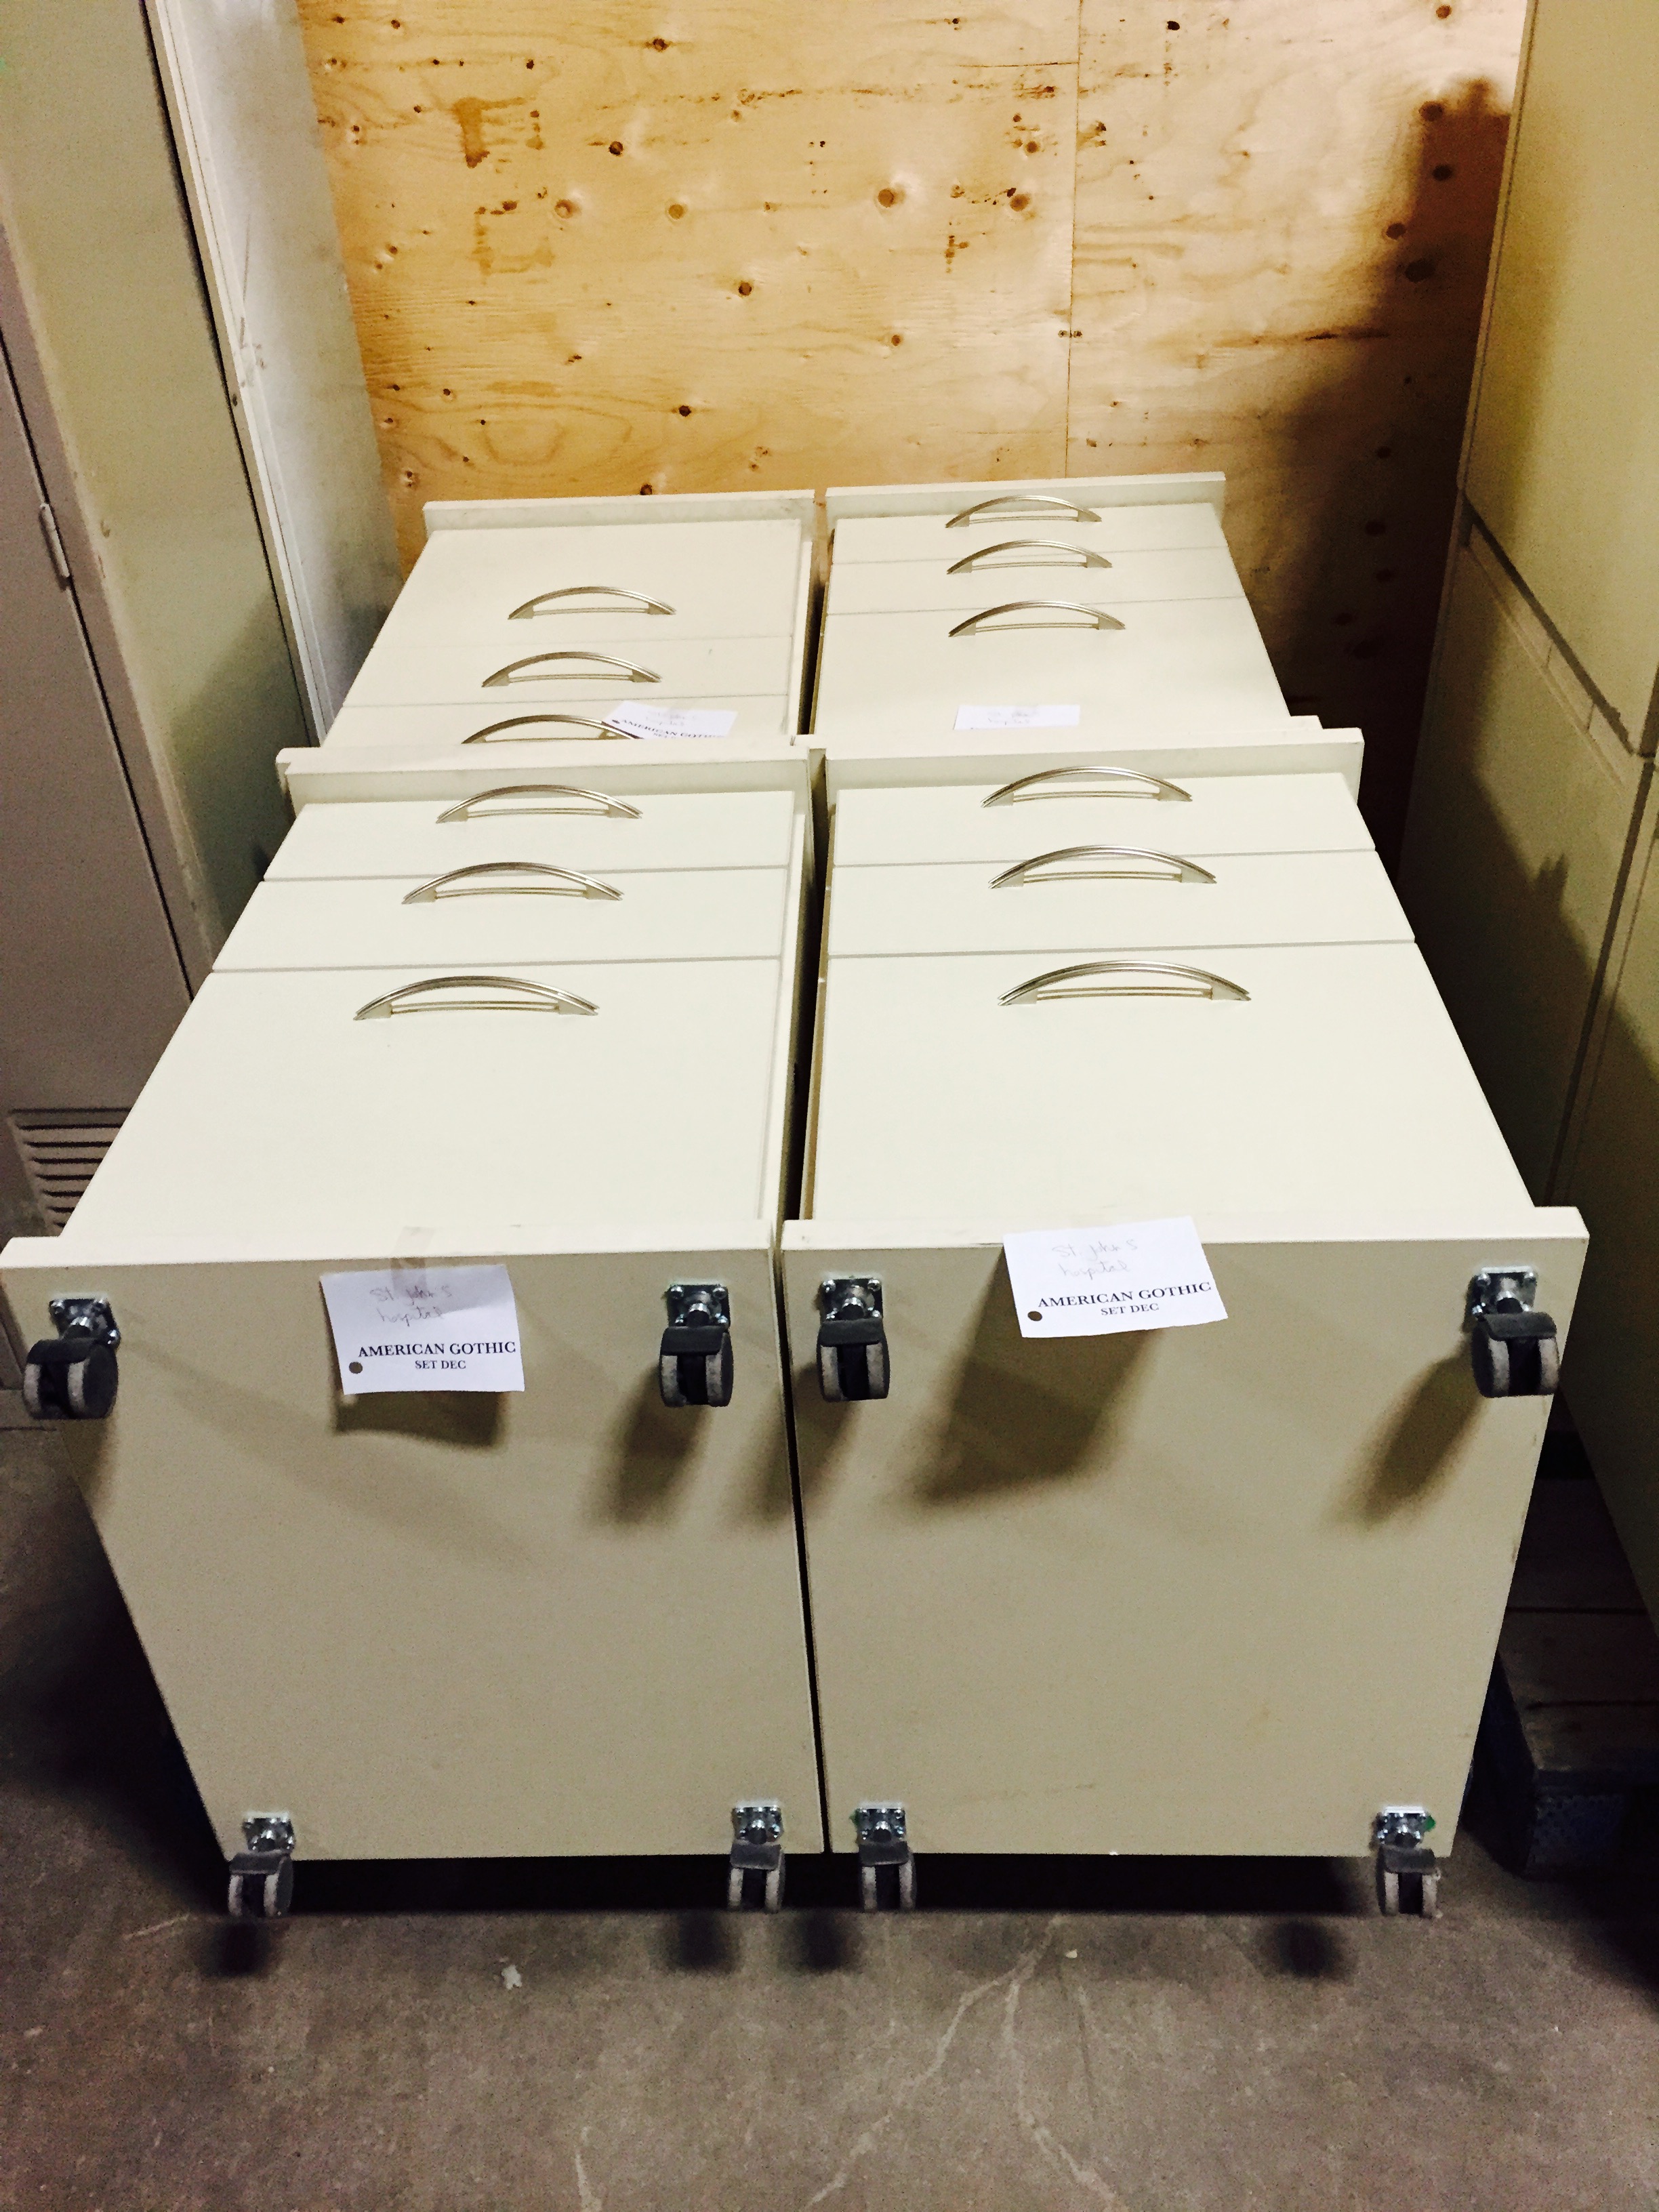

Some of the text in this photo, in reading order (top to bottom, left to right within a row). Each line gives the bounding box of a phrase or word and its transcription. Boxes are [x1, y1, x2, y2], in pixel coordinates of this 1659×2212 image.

[1038, 1282, 1212, 1308] AMERICAN GOTHIC
[1100, 1303, 1160, 1316] SET DEC
[358, 1341, 516, 1357] AMERICAN GOTHIC
[415, 1360, 466, 1370] SET DEC
